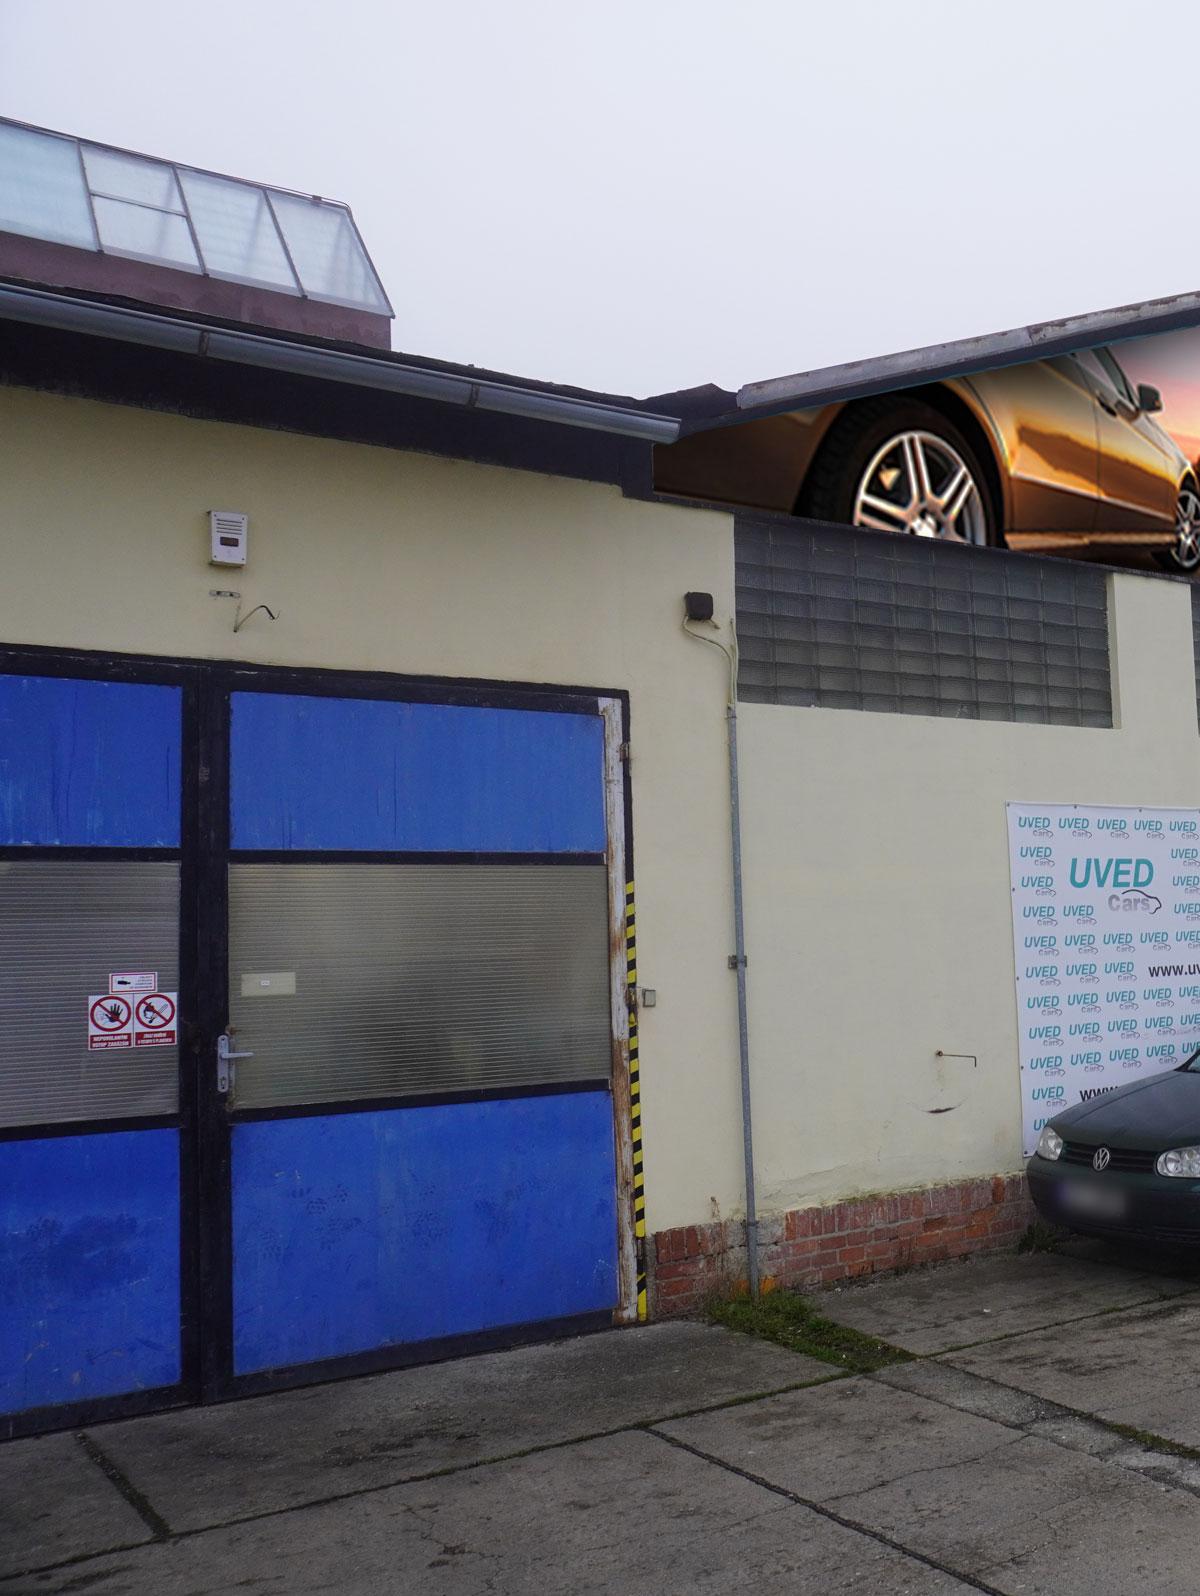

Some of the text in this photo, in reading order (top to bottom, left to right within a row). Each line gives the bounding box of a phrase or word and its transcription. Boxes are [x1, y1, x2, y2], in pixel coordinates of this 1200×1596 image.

[1018, 817, 1050, 828] UVED
[1058, 818, 1089, 828] UVED
[1096, 818, 1126, 829] UVED
[1133, 819, 1162, 830] UVED
[1169, 820, 1196, 830] UVED
[1019, 847, 1052, 858] UVED
[1170, 848, 1197, 858] UVED
[1069, 858, 1154, 888] UVED
[1021, 876, 1053, 888] UVED
[1172, 875, 1199, 886] UVED
[1108, 894, 1150, 912] Cars
[1173, 902, 1200, 913] UVED
[1022, 906, 1054, 918] UVED
[1062, 905, 1093, 917] UVED
[1024, 935, 1056, 948] UVED
[1064, 934, 1095, 946] UVED
[1102, 932, 1132, 944] UVED
[1139, 931, 1168, 943] UVED
[1025, 965, 1057, 978] UVED
[1065, 963, 1096, 976] UVED
[1104, 961, 1133, 973] UVED
[1067, 992, 1098, 1006] UVED
[1105, 990, 1135, 1003] UVED
[1142, 987, 1171, 1000] UVED
[1026, 995, 1059, 1009] UVED
[1107, 1018, 1136, 1032] UVED
[1144, 1015, 1172, 1028] UVED
[1028, 1025, 1060, 1039] UVED
[1068, 1022, 1099, 1035] UVED
[1108, 1047, 1138, 1061] UVED
[1145, 1044, 1174, 1057] UVED
[1029, 1055, 1062, 1070] UVED
[1070, 1051, 1101, 1065] UVED
[1031, 1086, 1063, 1100] UVED
